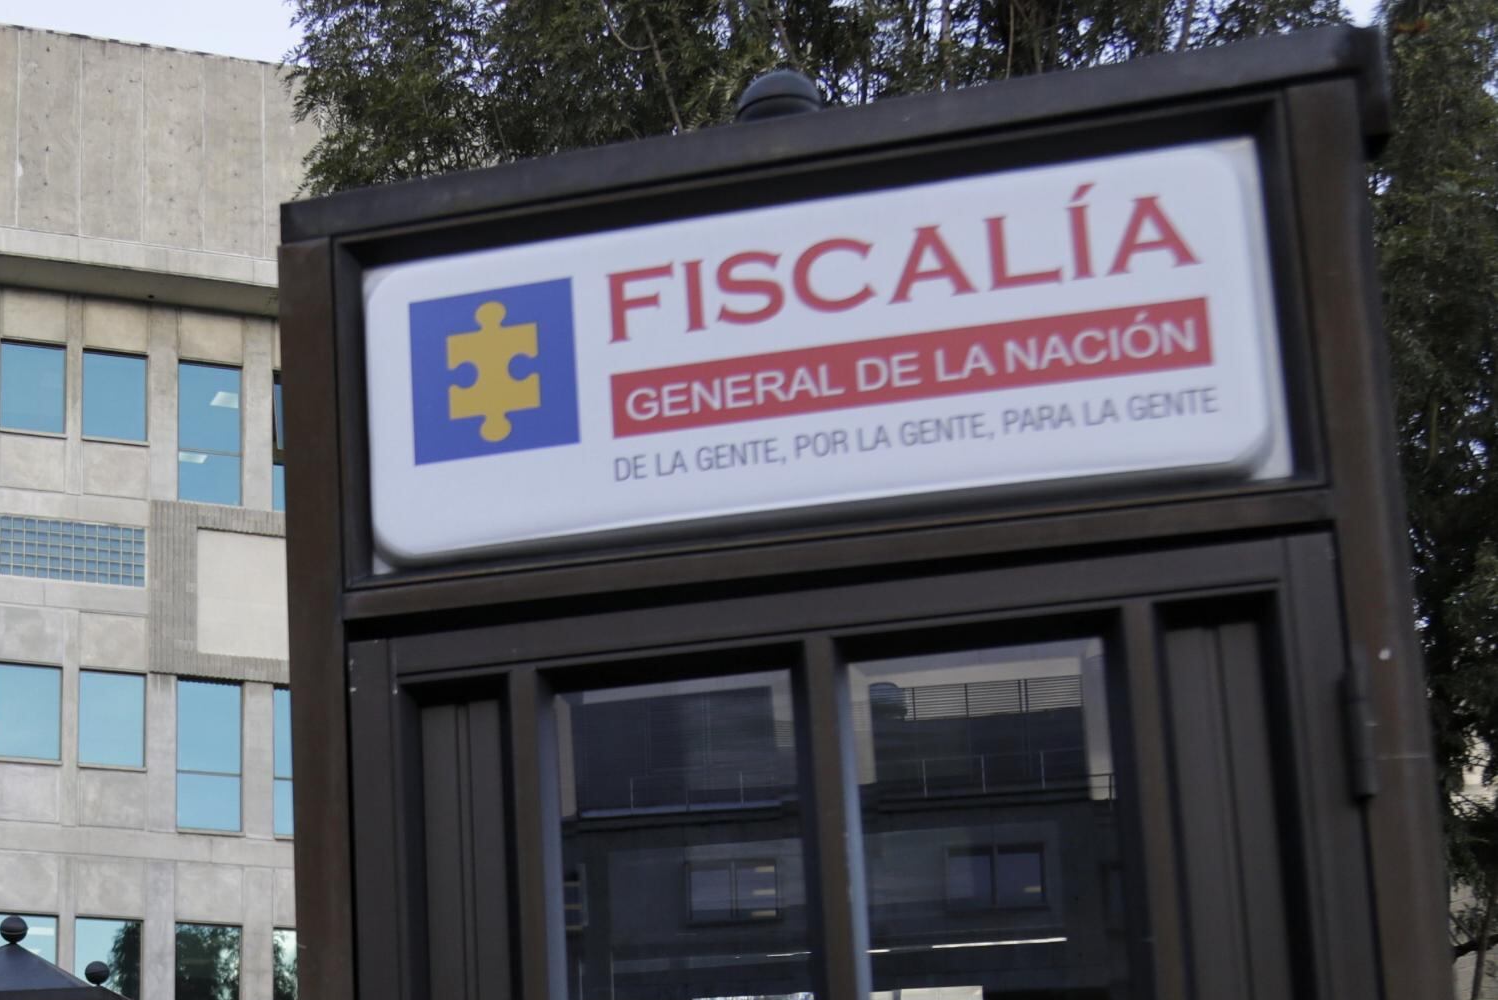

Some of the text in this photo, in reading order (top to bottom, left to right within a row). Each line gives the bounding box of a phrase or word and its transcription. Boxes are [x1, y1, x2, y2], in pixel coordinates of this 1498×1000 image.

[606, 181, 1202, 344] FISCALÍA
[624, 311, 1199, 422] GENERAL DE LA NACIÓN
[613, 386, 1221, 483] DE LA GENTE, POR LA GENTE, PARA LA GENTE
